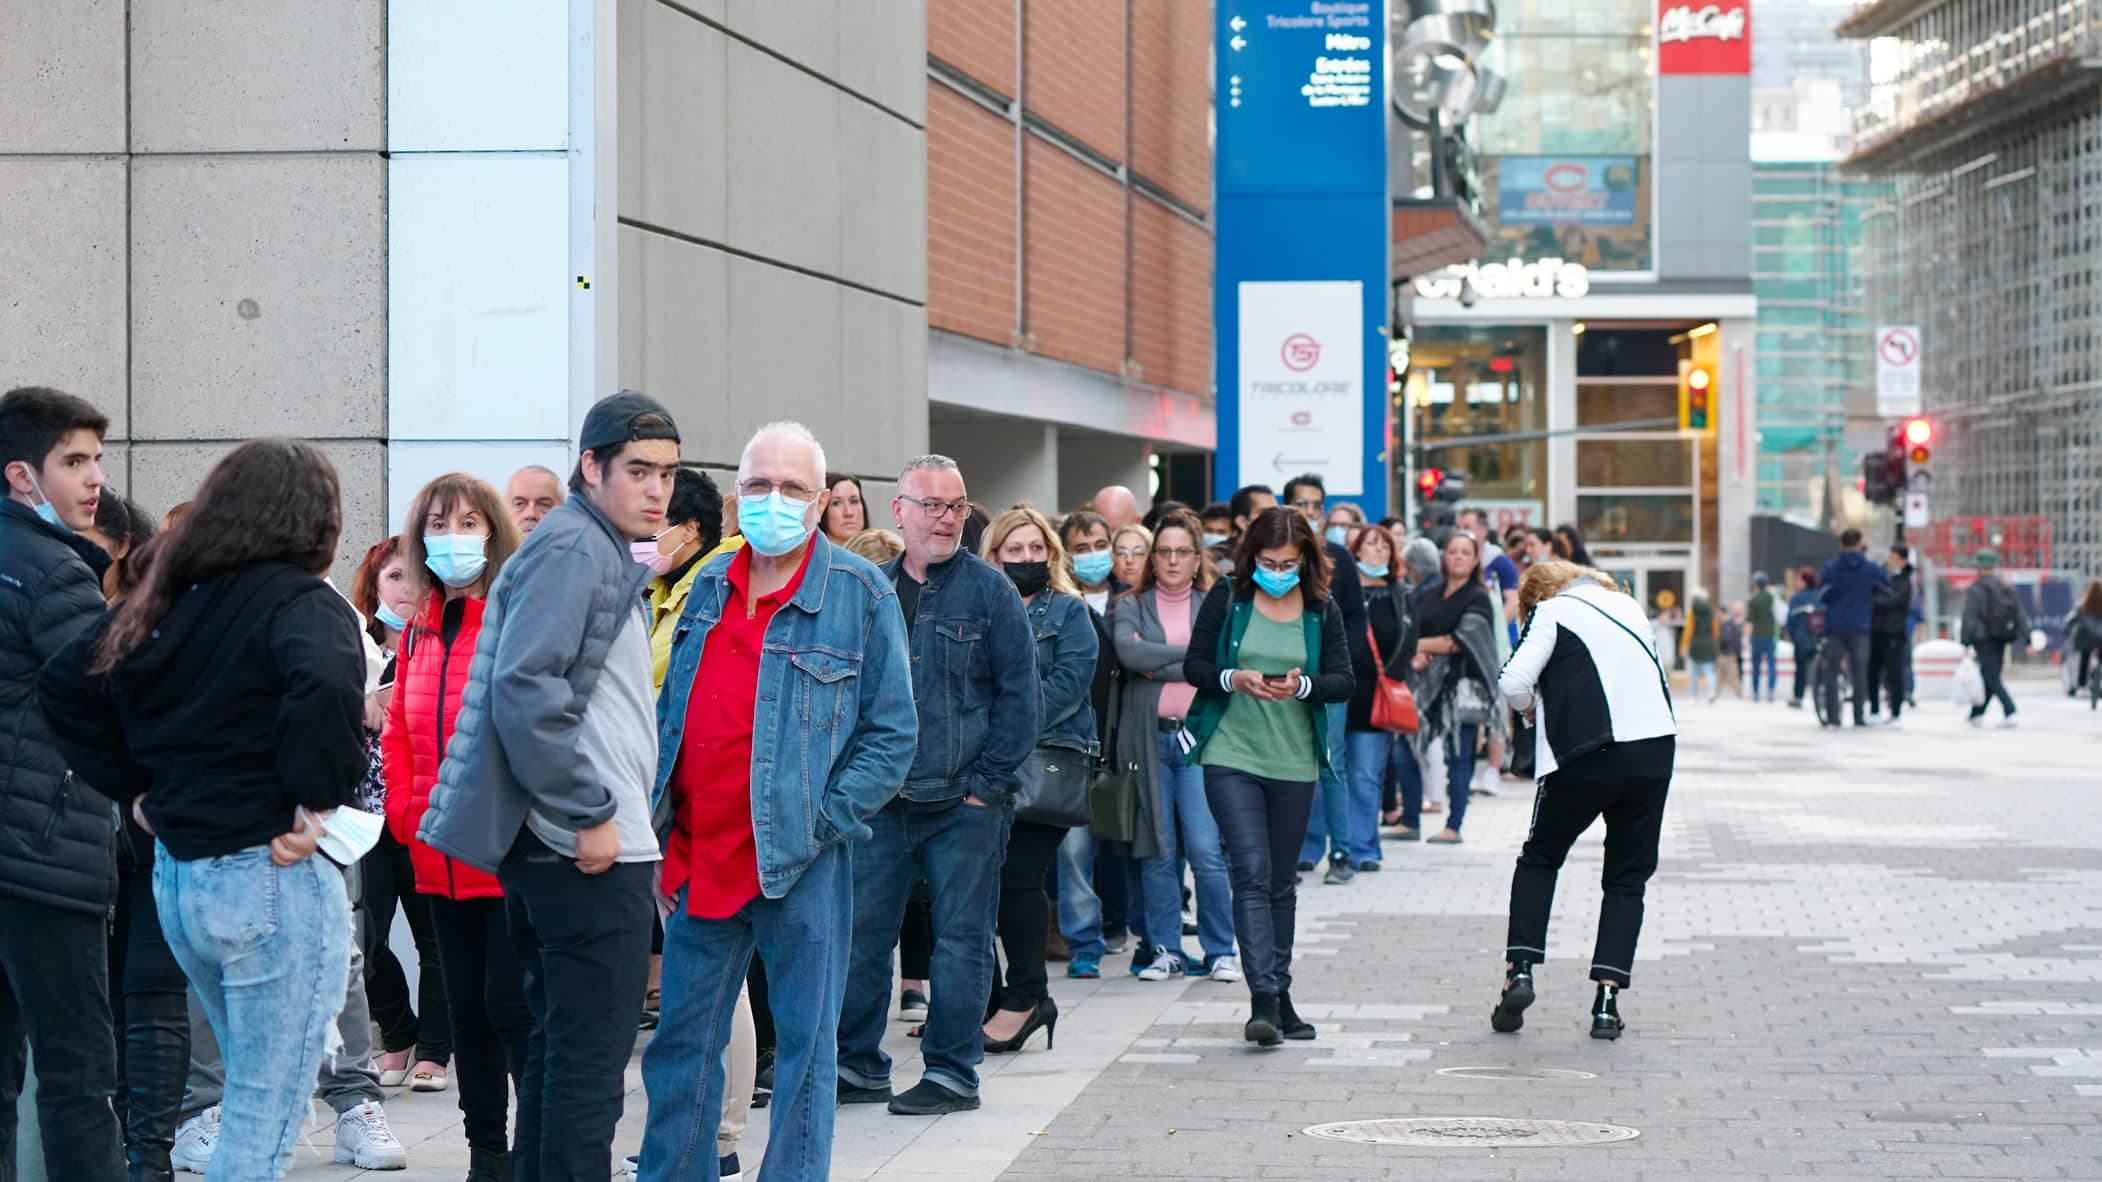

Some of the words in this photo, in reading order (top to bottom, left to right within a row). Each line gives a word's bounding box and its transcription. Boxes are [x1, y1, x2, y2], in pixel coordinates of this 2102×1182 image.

[1311, 2, 1369, 15] Boutique
[1266, 15, 1324, 28] Tricolore
[1327, 15, 1369, 28] Sports
[1250, 381, 1353, 395] TRICOLORE
